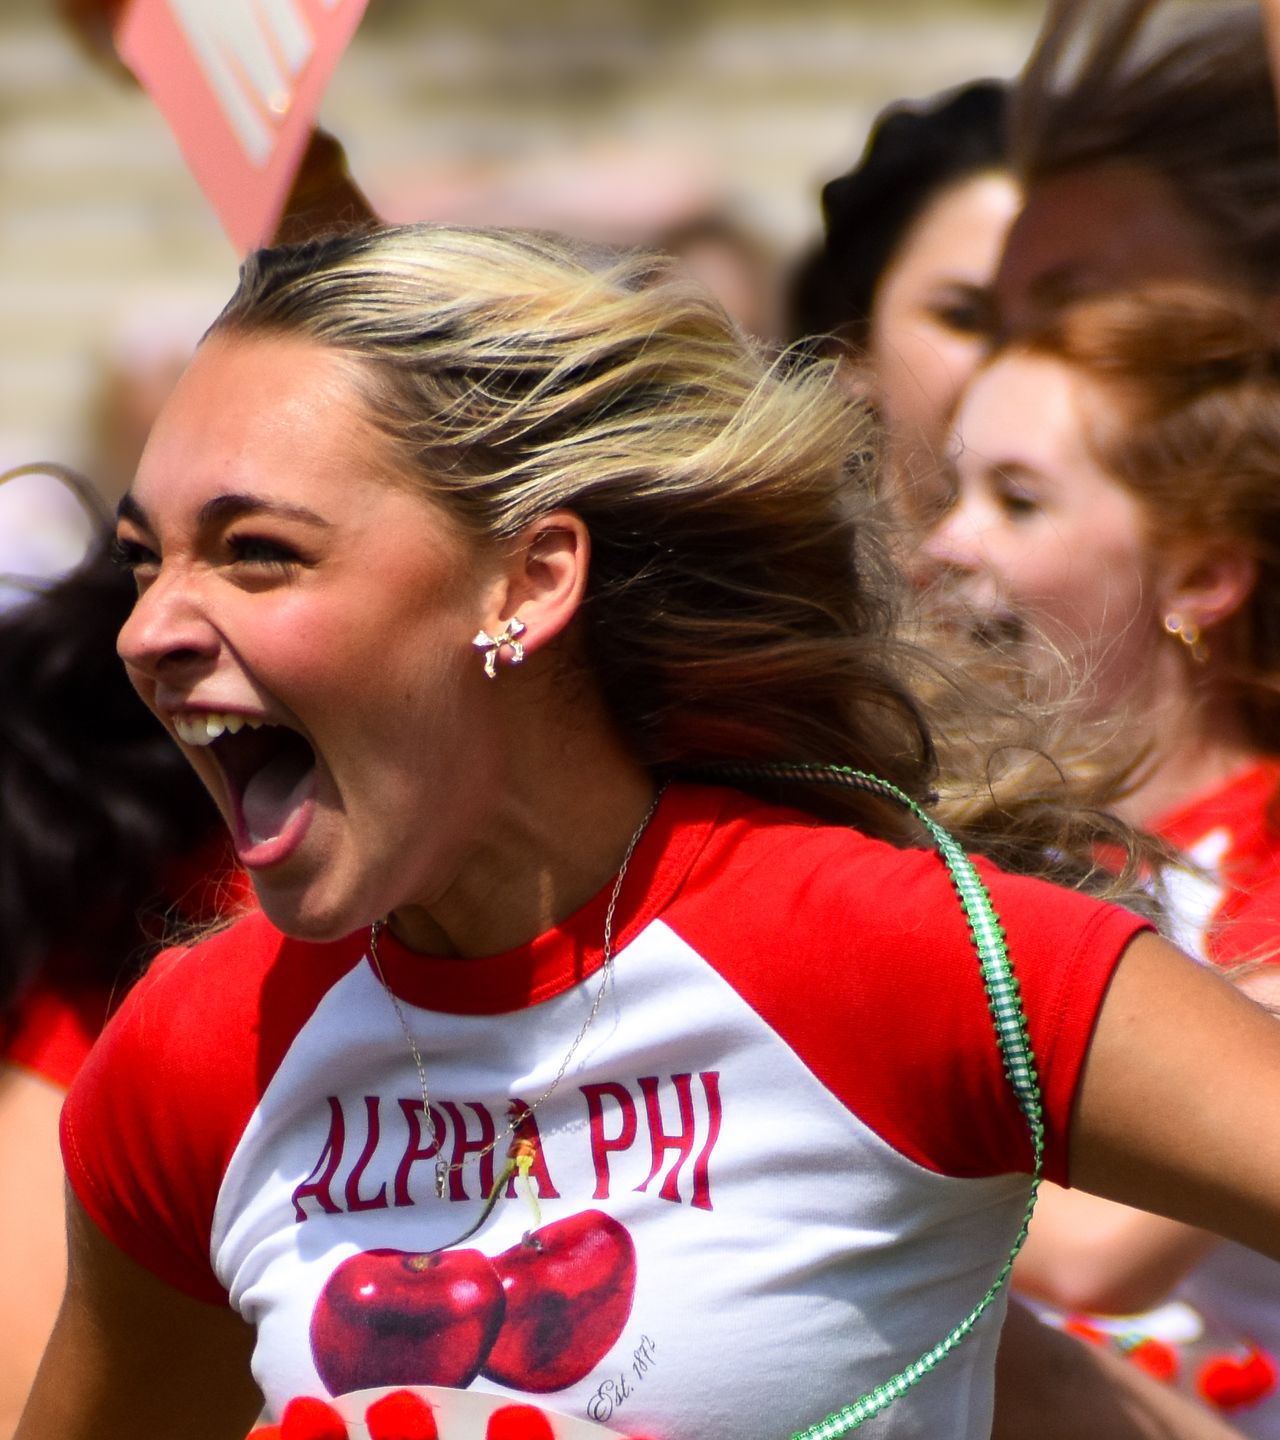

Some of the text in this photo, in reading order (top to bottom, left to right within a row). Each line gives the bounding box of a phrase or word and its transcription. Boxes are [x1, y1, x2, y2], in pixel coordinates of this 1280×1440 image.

[292, 1070, 722, 1223] ALPHA PHI
[586, 1334, 656, 1423] Est. 1872
